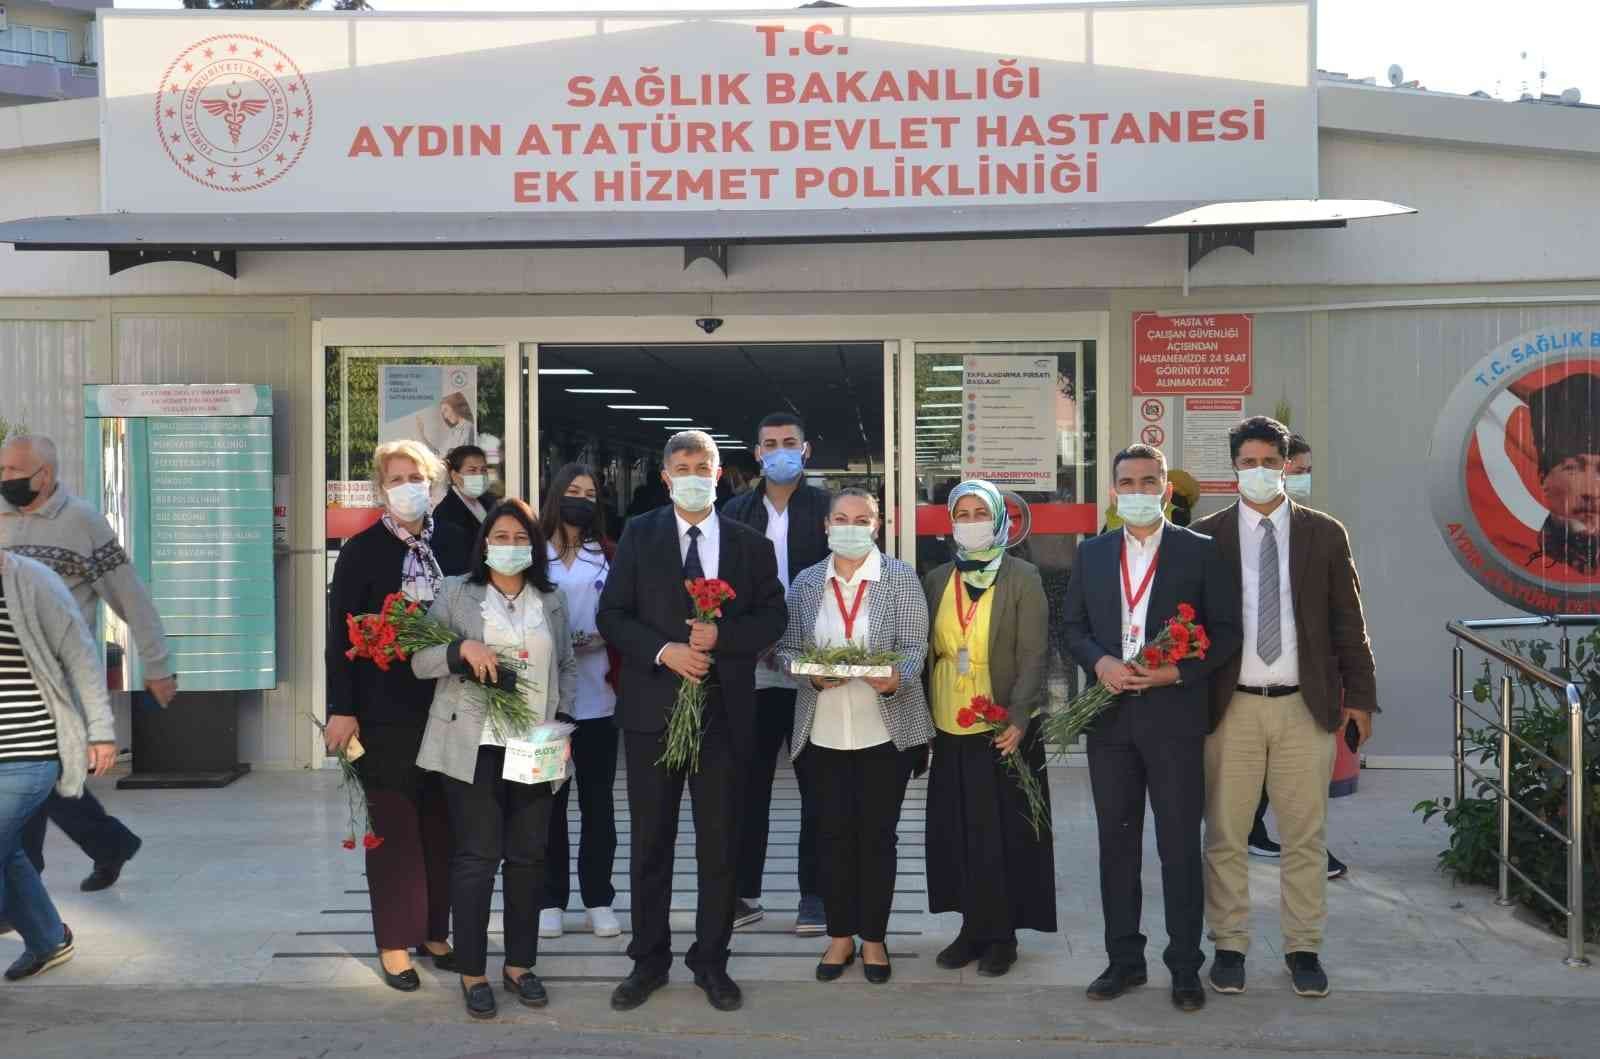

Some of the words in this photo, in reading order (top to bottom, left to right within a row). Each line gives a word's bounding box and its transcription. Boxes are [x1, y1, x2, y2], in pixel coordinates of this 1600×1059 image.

[758, 25, 848, 55] T.C.
[567, 67, 748, 107] SAĞLIK
[768, 60, 1040, 104] BAKANLIĞI
[350, 124, 501, 159] AYDIN
[519, 114, 754, 154] ATATÜRK
[772, 117, 960, 151] DEVLET
[977, 101, 1265, 147] HASTANESİ
[514, 171, 576, 203] EK
[596, 163, 776, 201] HİZMET
[797, 154, 1098, 198] POLİKLİNİĞİ
[1204, 317, 1216, 326] VE
[1224, 353, 1247, 363] SAAT
[1474, 360, 1511, 387] T.C.
[1510, 331, 1584, 364] SAĞLIK
